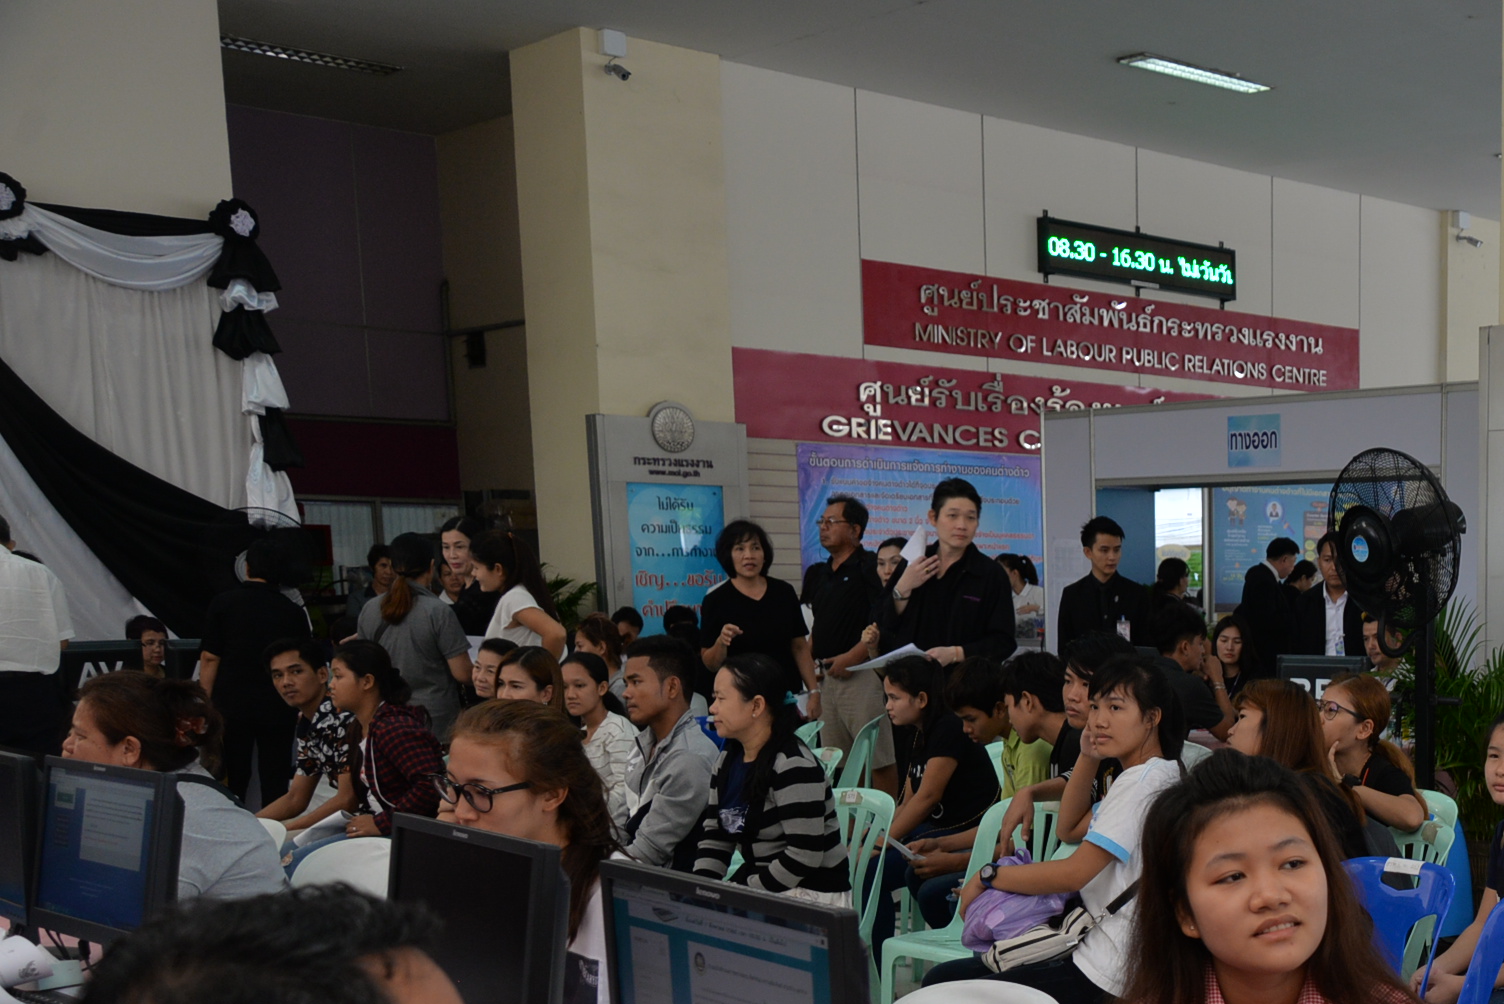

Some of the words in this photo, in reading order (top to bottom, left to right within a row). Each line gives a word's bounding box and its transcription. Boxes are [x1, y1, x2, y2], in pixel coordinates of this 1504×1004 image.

[1048, 236, 1096, 262] 08.30
[1111, 247, 1155, 272] 16.30
[920, 280, 1324, 355] ศูนย์ประชาสัมพันธ์กระทรวงแรงงาน
[915, 322, 1002, 349] MINISTRY
[1009, 333, 1036, 354] OF
[1042, 337, 1116, 363] LABOUR
[1122, 346, 1179, 371] PUBLIC
[1184, 354, 1266, 380] RELATIONS
[1271, 364, 1327, 386] CENTRE
[822, 415, 1008, 448] GRIEVANCES
[1230, 430, 1278, 451] ทางออก
[633, 455, 714, 469] กระทรวงแรงงาน
[656, 494, 694, 511] ไม่ได้รับ
